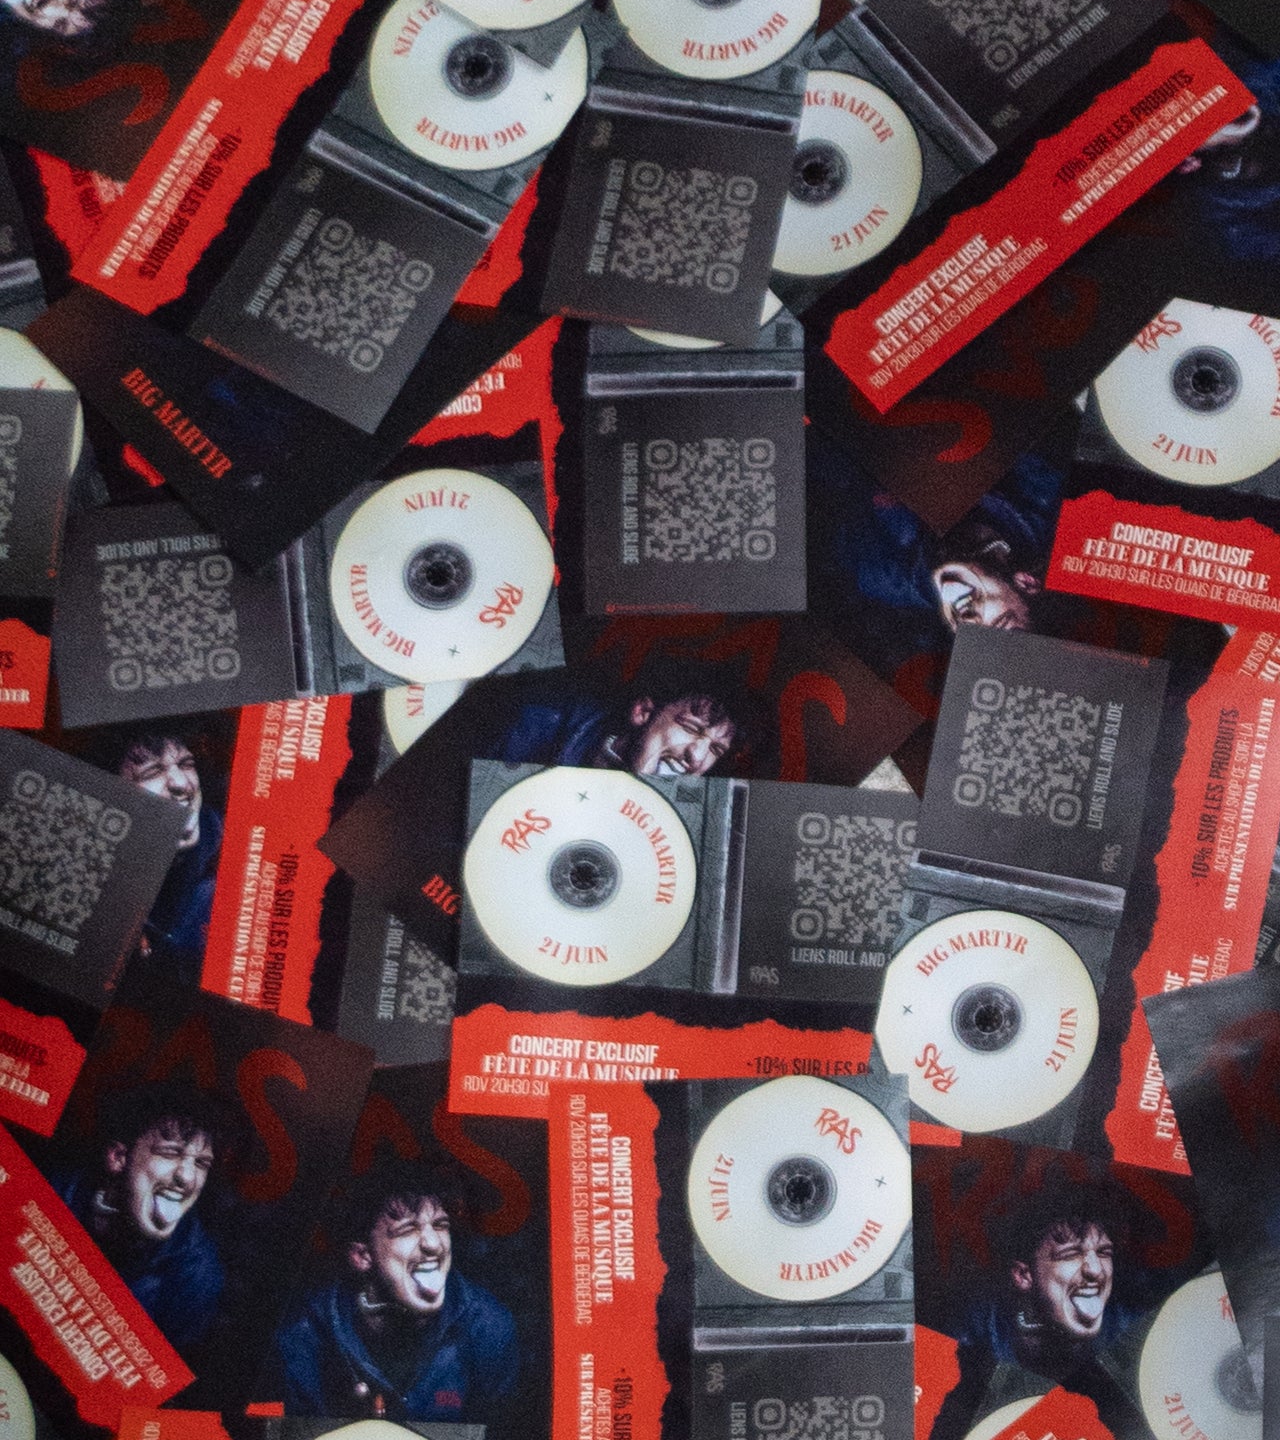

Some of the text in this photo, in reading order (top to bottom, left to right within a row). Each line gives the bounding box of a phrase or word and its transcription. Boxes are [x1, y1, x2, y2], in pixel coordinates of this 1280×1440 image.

[680, 11, 789, 62] BIG MARTYR
[866, 232, 1024, 367] FÊTE DE LA MUSIQUE
[872, 231, 994, 338] CONCERT EXCLUSIF
[1061, 553, 1087, 574] RDV
[1086, 559, 1127, 582] 20H30
[1126, 567, 1149, 586] SUR
[1148, 571, 1173, 591] LES
[1173, 576, 1209, 599] QUAIS
[1208, 583, 1227, 602] DE
[1083, 537, 1271, 594] FÊTE DE LA MUSIQUE
[1110, 522, 1255, 570] CONCERT EXCLUSIF
[1085, 700, 1126, 830] LIENS ROLL AND SLIDE
[498, 807, 553, 854] RAS
[618, 798, 677, 906] BIG MARTYR
[536, 937, 609, 967] 21 JUIN
[813, 1106, 863, 1156] RAS
[569, 1093, 592, 1325] RDV 20H30 SUR LES QUAIS DE BERGERAC
[589, 1111, 614, 1304] FÊTE DE LA MUSIQUE
[610, 1135, 634, 1281] CONCERT EXCLUSIF
[706, 1154, 734, 1224] 21 JUIN
[777, 1218, 884, 1283] BIG MARTYR
[728, 1401, 746, 1435] LIENS
